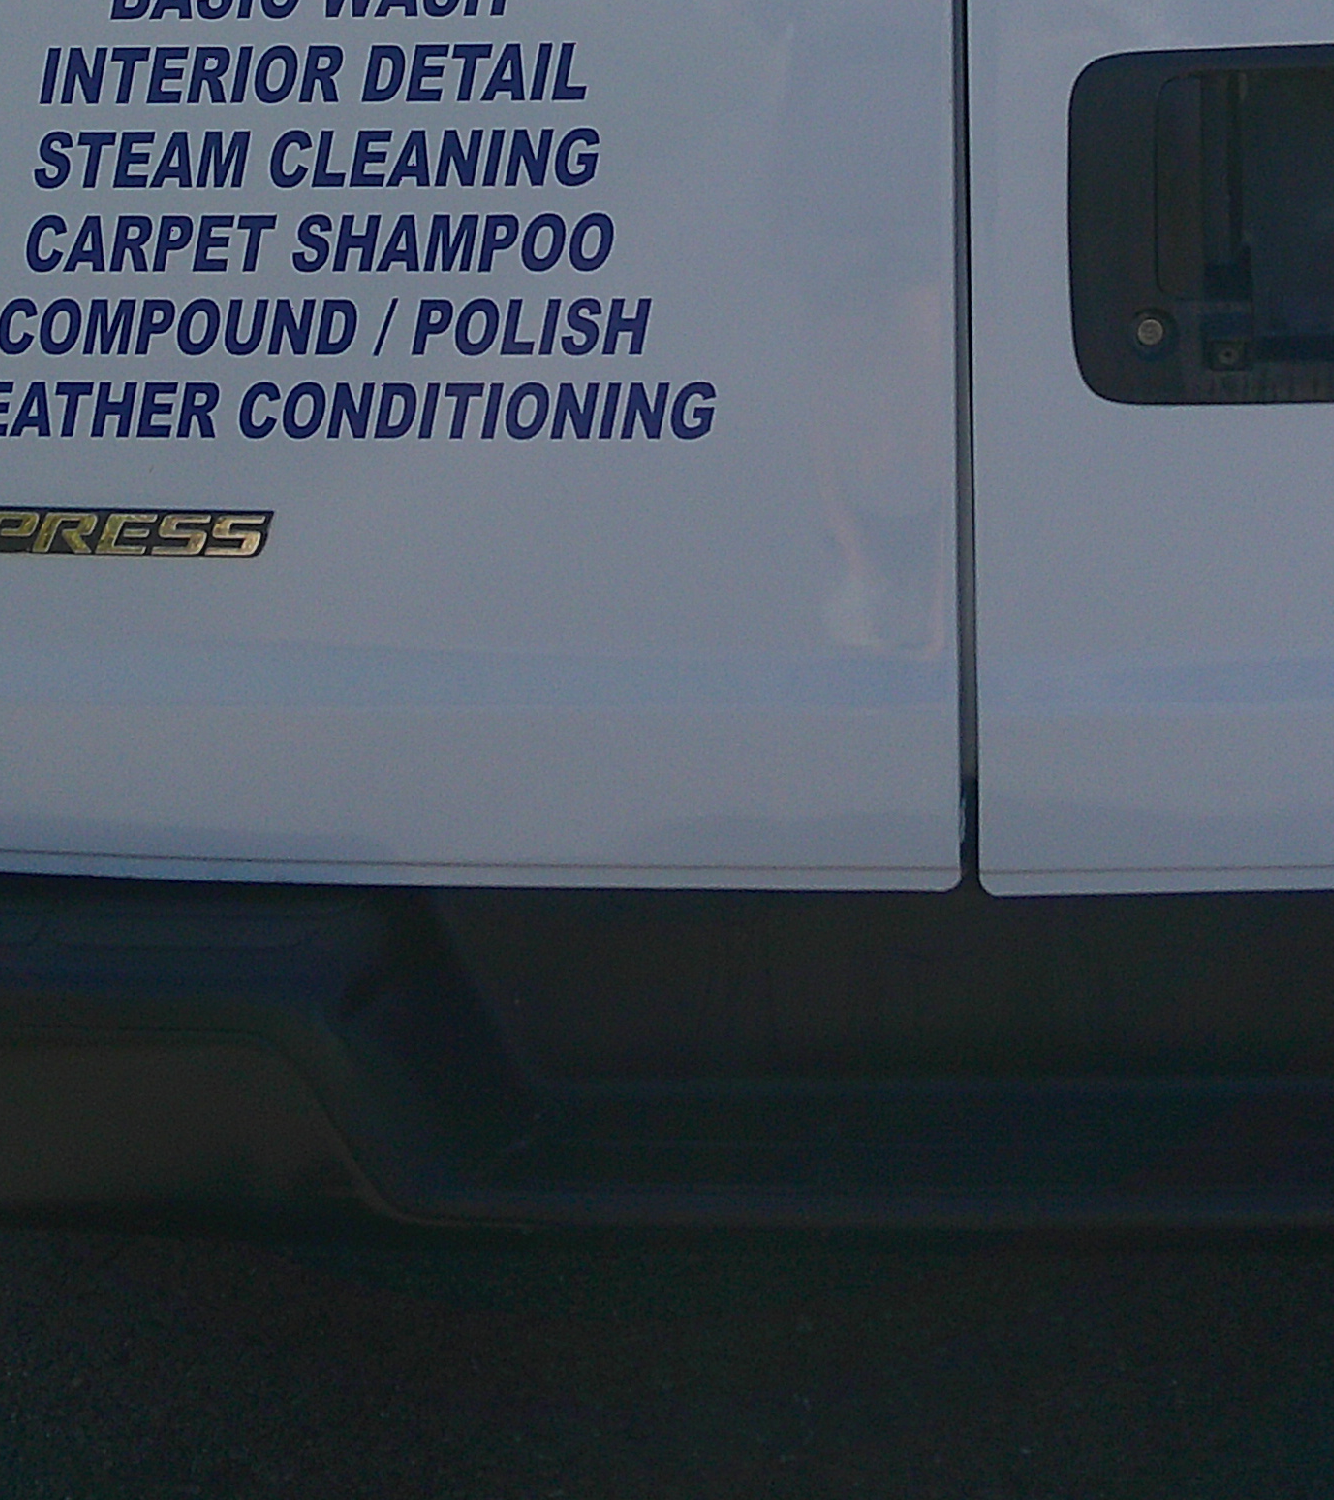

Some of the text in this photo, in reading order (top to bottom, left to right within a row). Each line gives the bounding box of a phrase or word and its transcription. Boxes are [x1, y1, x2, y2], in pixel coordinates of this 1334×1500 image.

[40, 43, 586, 104] INTERIOR DETAIL
[35, 128, 600, 189] STEAM CLEANING
[26, 213, 614, 272] CARPET SHAMPOO
[374, 298, 398, 356] /
[412, 298, 651, 355] POLISH
[239, 382, 716, 440] CONDITIONING
